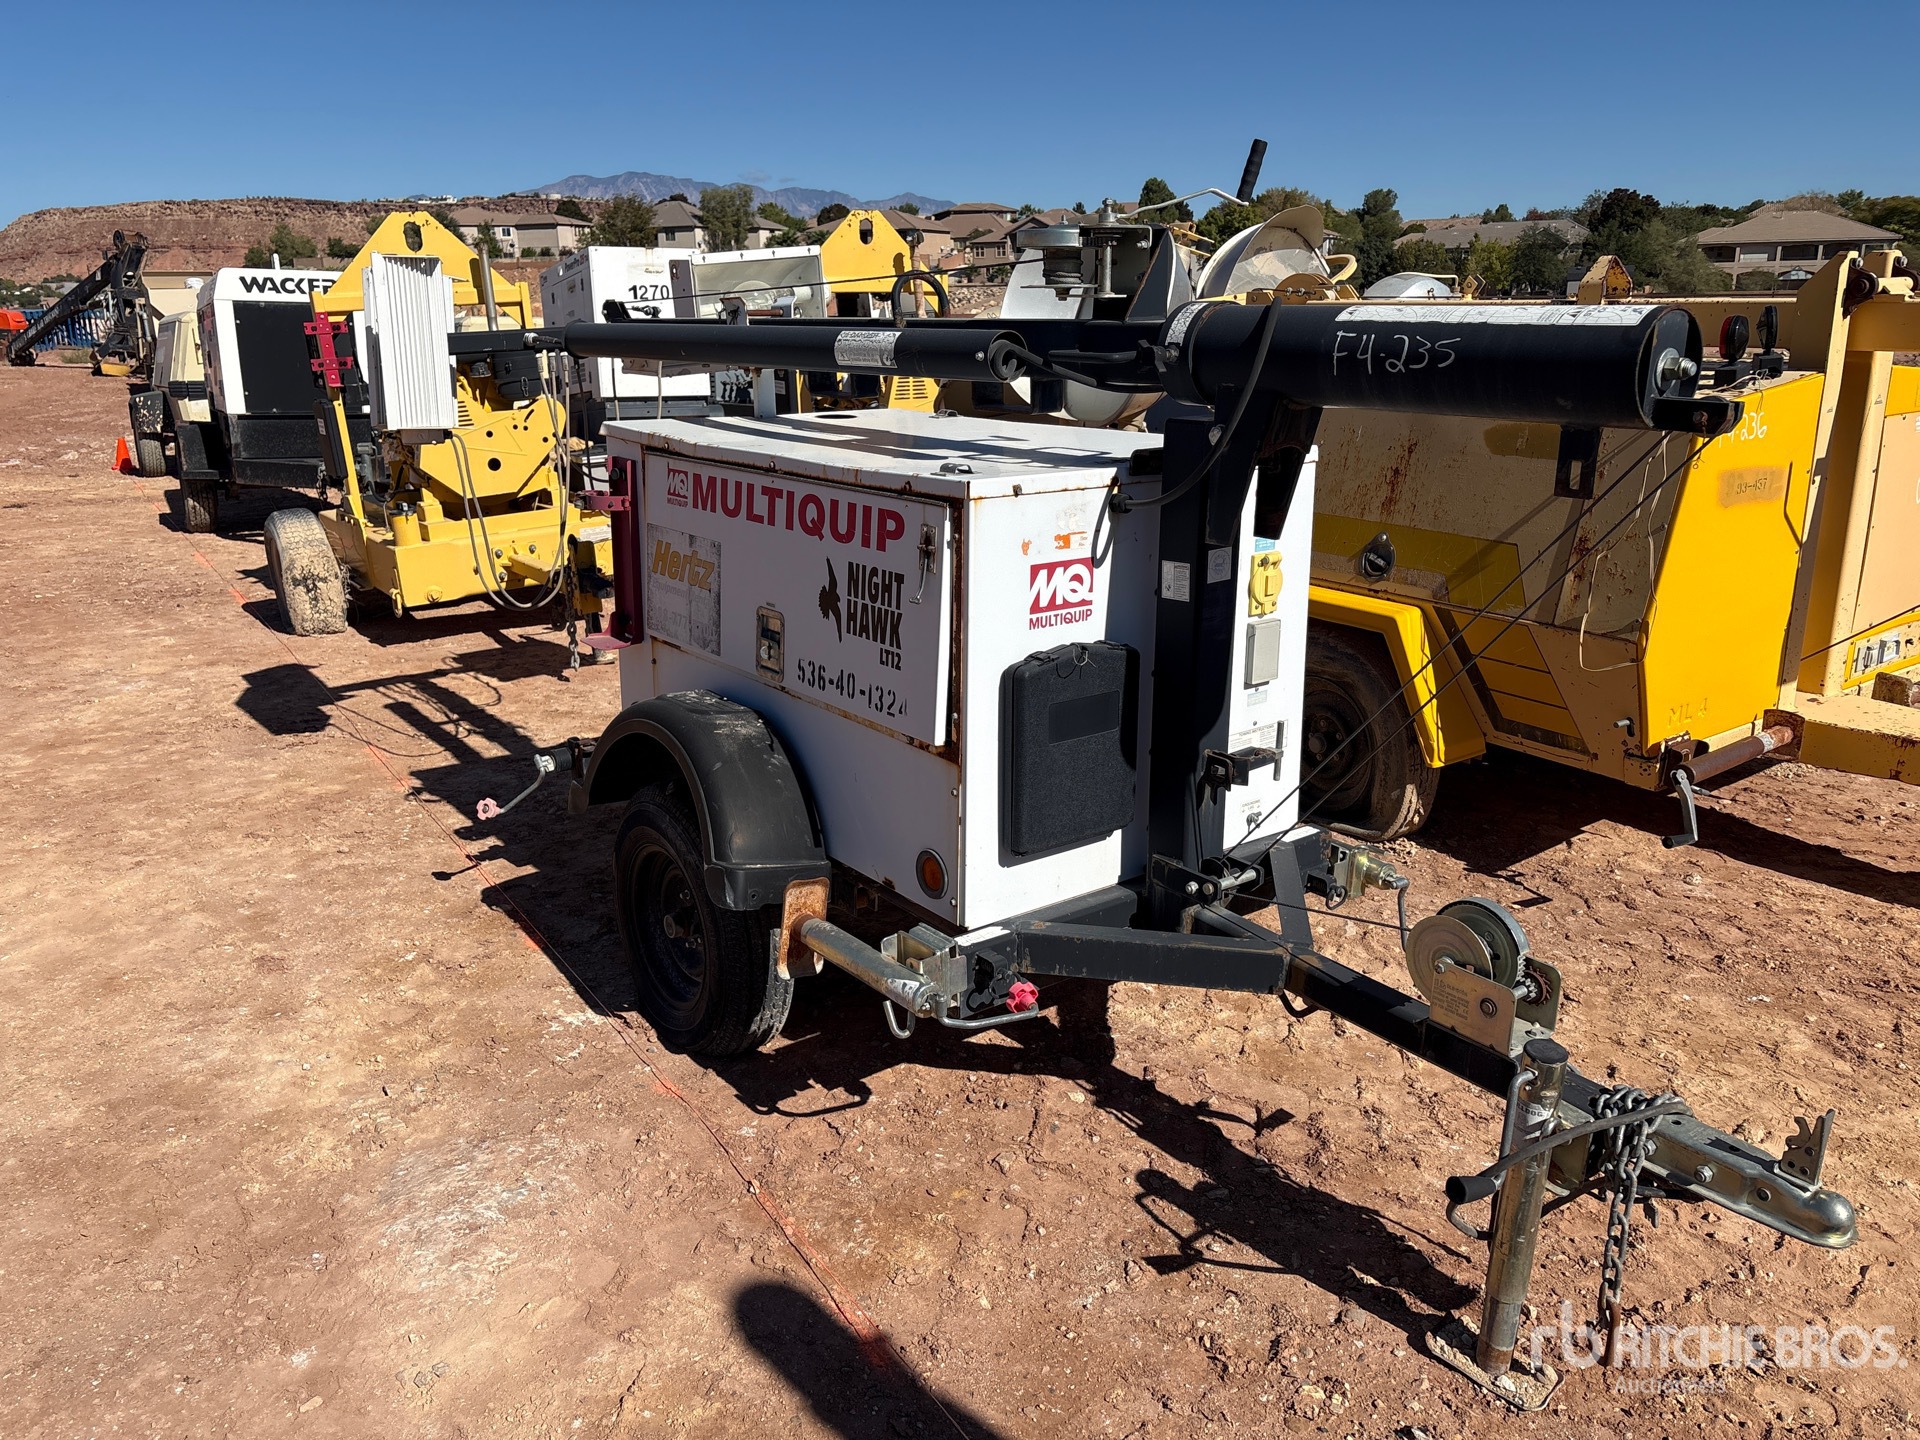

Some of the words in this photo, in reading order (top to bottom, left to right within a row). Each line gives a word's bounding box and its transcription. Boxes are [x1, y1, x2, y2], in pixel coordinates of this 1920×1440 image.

[628, 284, 670, 301] 1270
[667, 470, 689, 499] MQ
[692, 472, 906, 553] MULTIQUIP
[651, 539, 716, 593] Hertz
[846, 560, 905, 611] NIGHT
[1029, 558, 1094, 614] MQ
[845, 597, 903, 650] HAWK
[1028, 608, 1093, 631] MULTIQUIP
[879, 647, 902, 671] LT12
